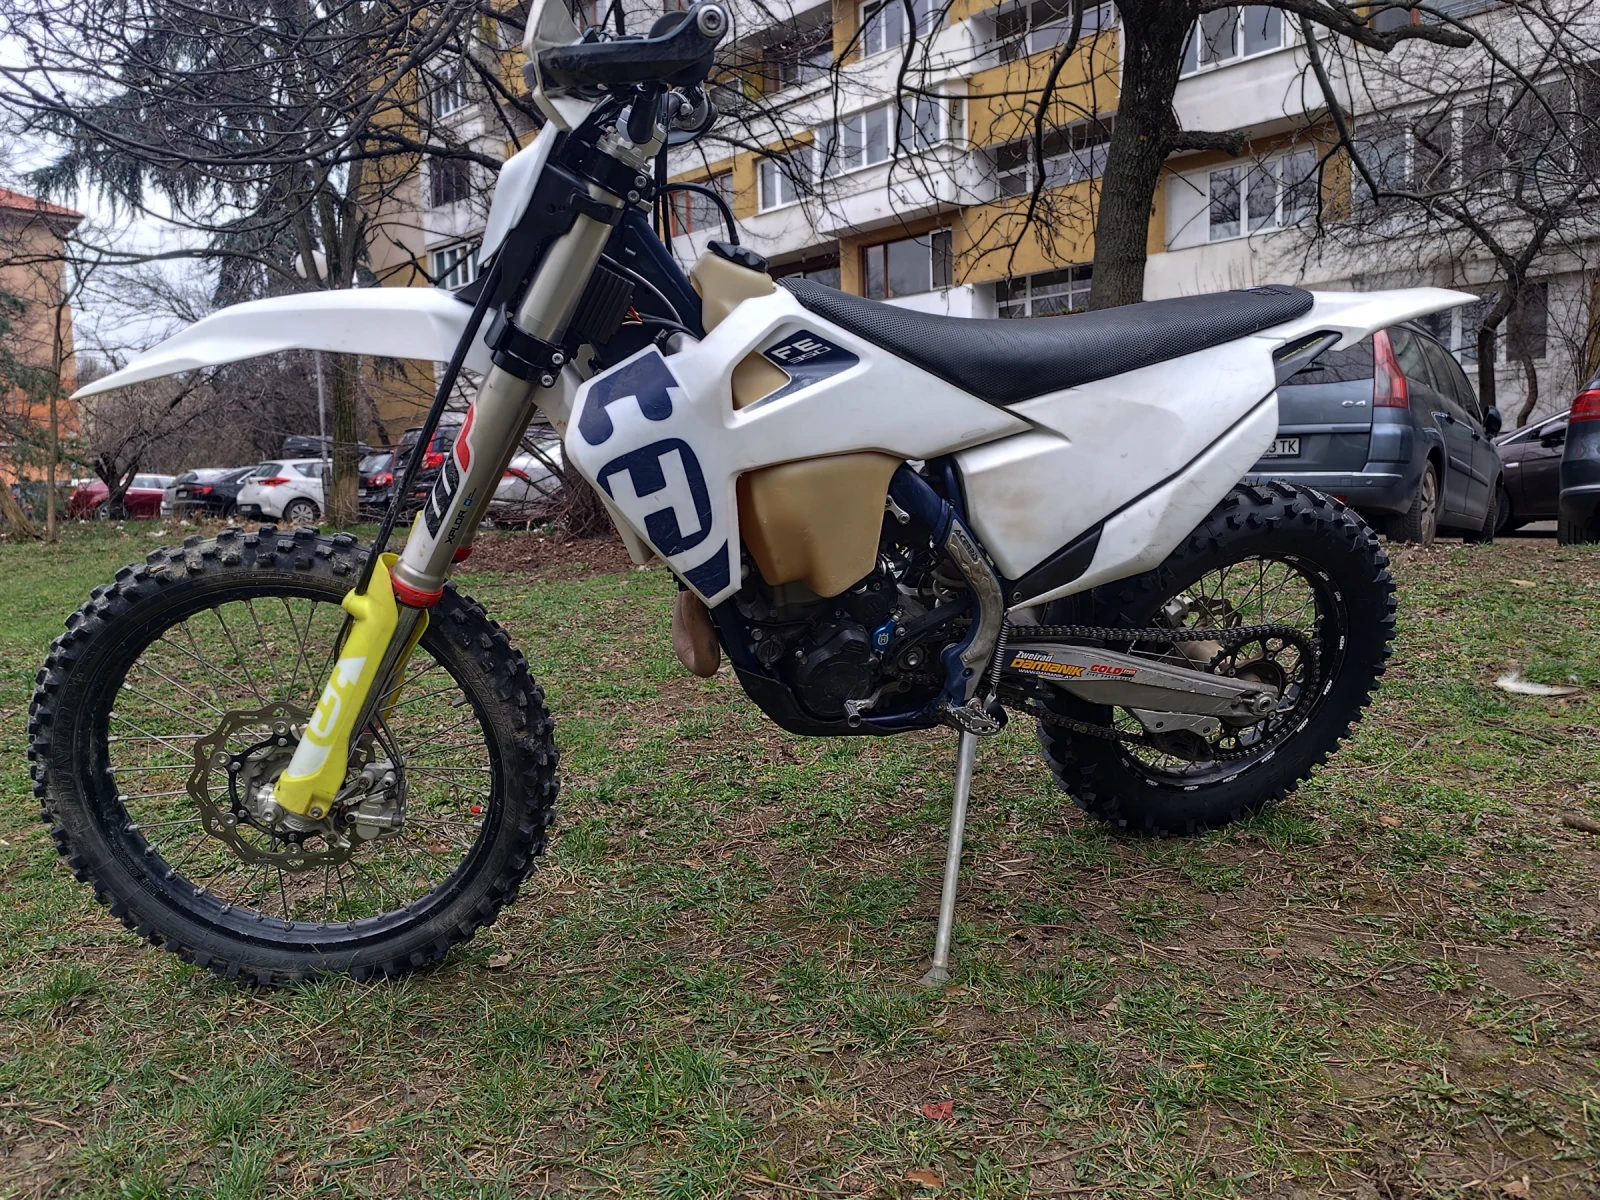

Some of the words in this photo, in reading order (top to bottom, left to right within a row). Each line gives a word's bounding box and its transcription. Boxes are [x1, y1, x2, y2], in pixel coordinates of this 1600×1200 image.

[771, 338, 823, 360] FE
[1342, 400, 1367, 408] C4
[1279, 440, 1297, 453] TK
[444, 509, 467, 545] XPLOR
[1016, 650, 1053, 662] Zweirad
